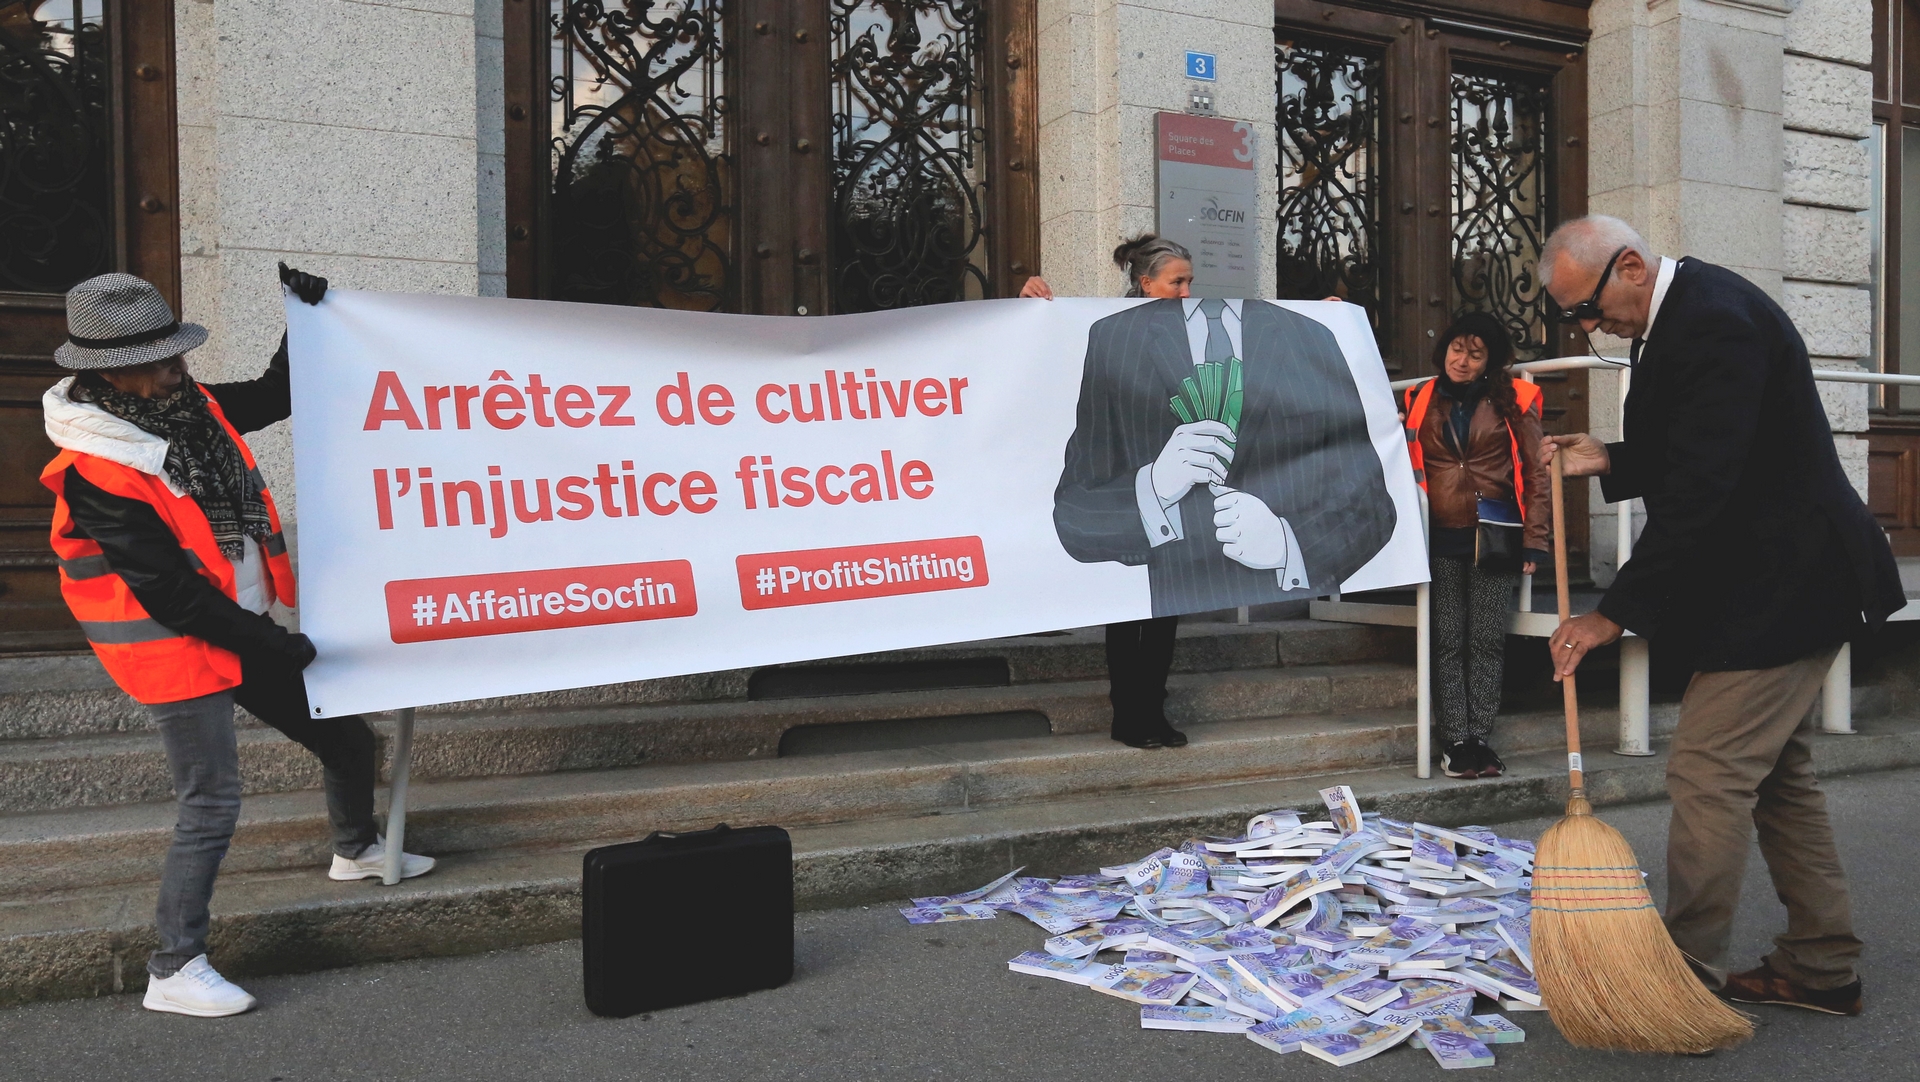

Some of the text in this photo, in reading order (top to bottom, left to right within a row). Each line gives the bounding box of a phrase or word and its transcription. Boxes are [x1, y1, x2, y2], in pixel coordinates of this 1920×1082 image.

[1195, 58, 1206, 74] 3
[1168, 132, 1214, 145] Square des
[1232, 122, 1254, 162] 3
[1168, 145, 1196, 156] Places
[1169, 191, 1175, 199] 2
[1200, 206, 1245, 223] SOCFIN
[362, 368, 969, 431] Arrêtez de cultiver
[735, 450, 934, 510] fiscale
[755, 552, 975, 597] #ProfitShifting
[411, 577, 677, 627] #AffaireSocfin
[1137, 861, 1160, 878] 1000
[1104, 964, 1128, 981] 1000
[1383, 1013, 1410, 1027] 1000
